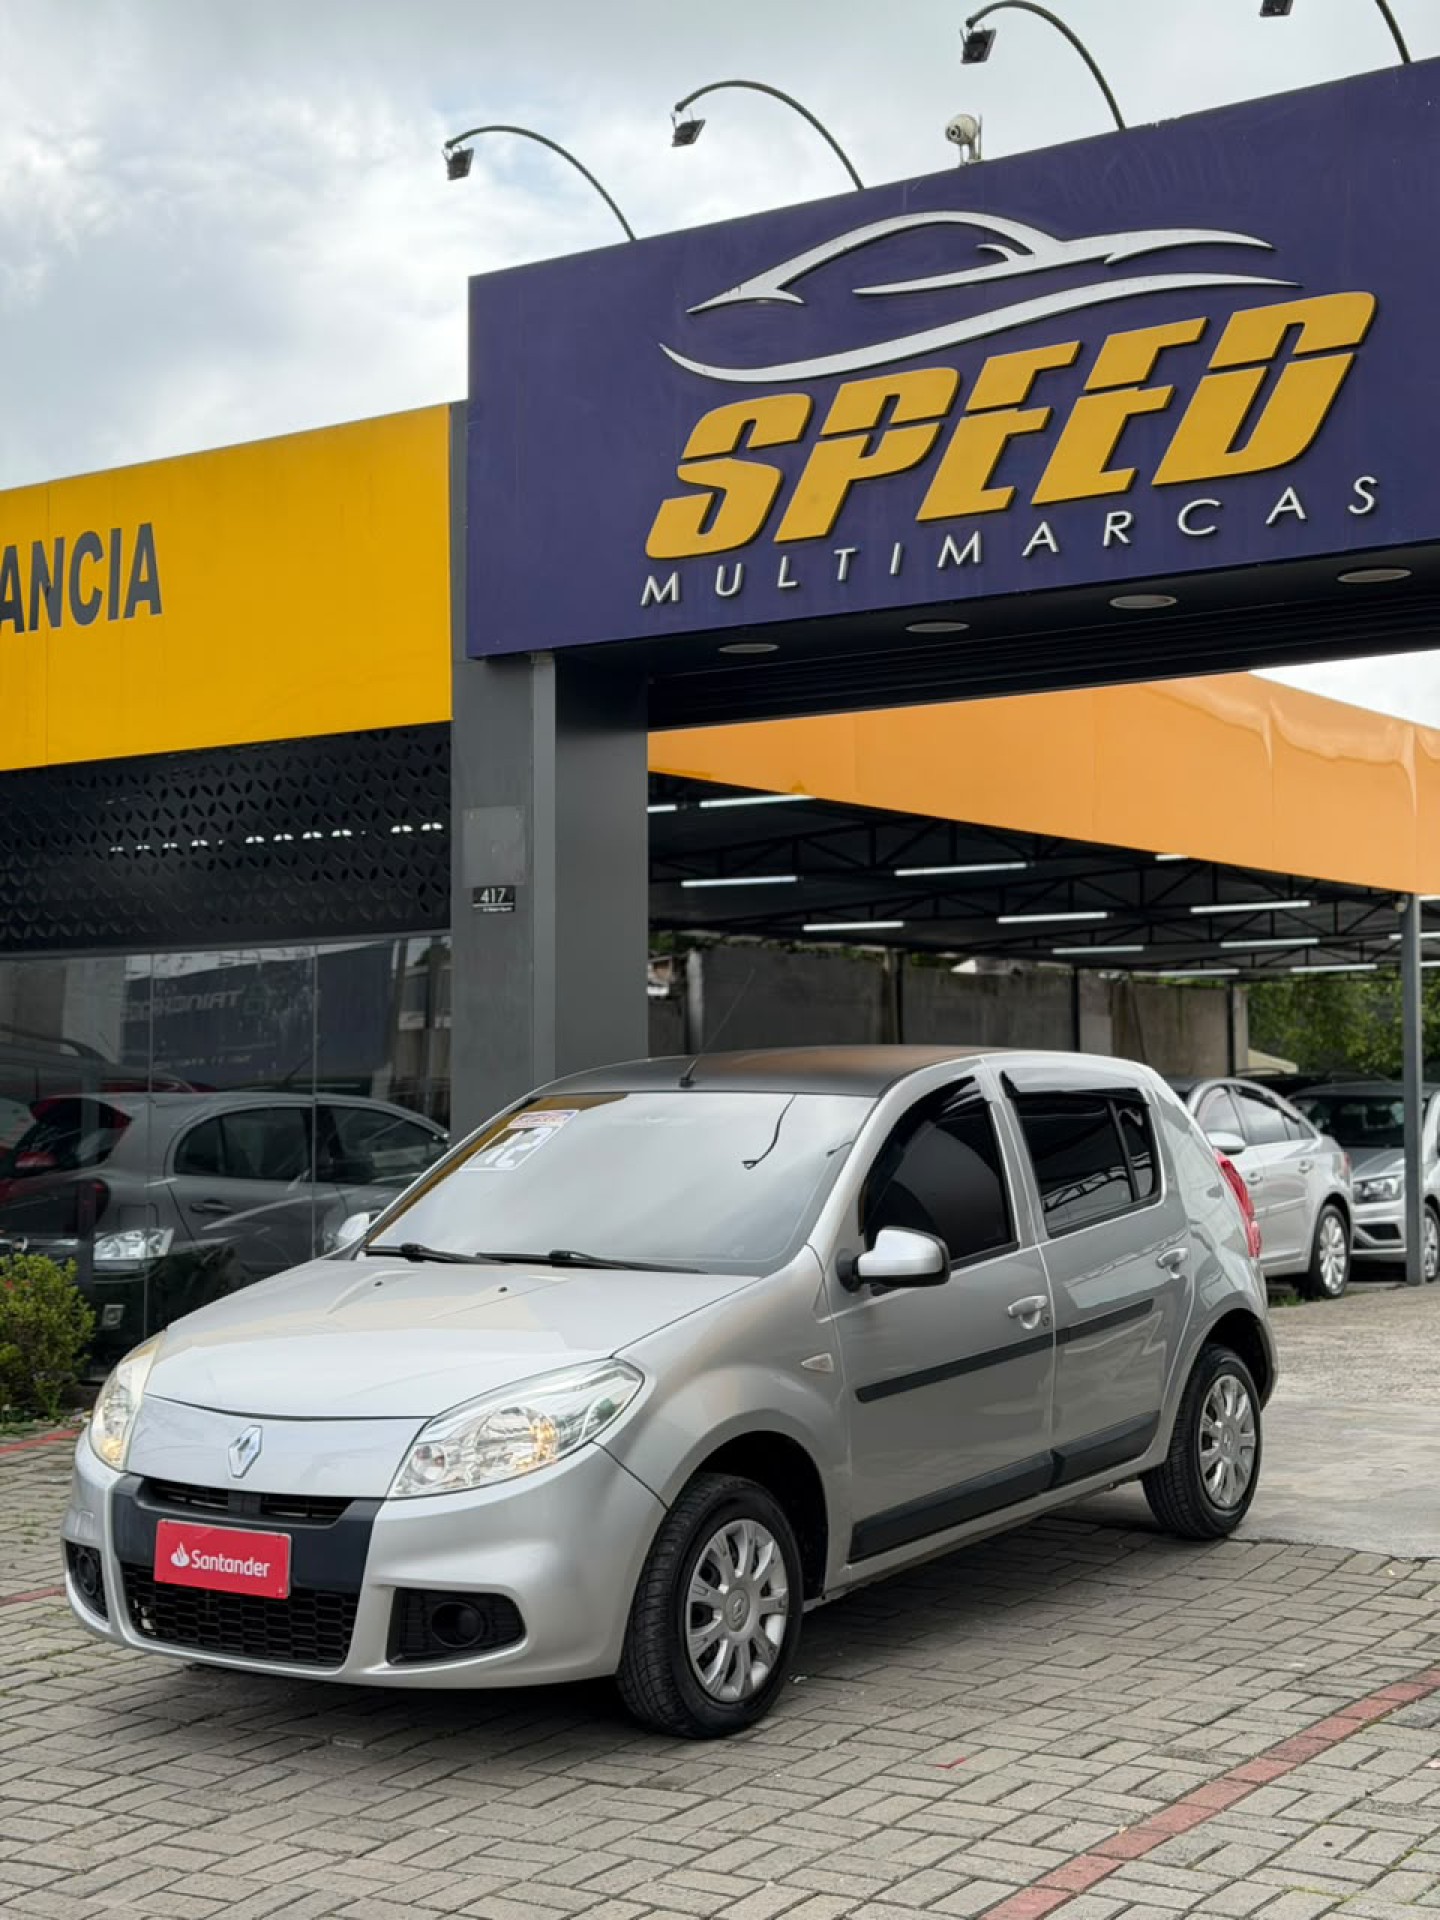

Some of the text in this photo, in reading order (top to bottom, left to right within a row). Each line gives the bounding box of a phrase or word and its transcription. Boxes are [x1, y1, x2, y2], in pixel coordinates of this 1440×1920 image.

[646, 291, 1377, 558] SPEED
[641, 475, 1380, 606] MULTIMARCAS
[479, 887, 507, 904] 417
[190, 1549, 271, 1578] Santander
